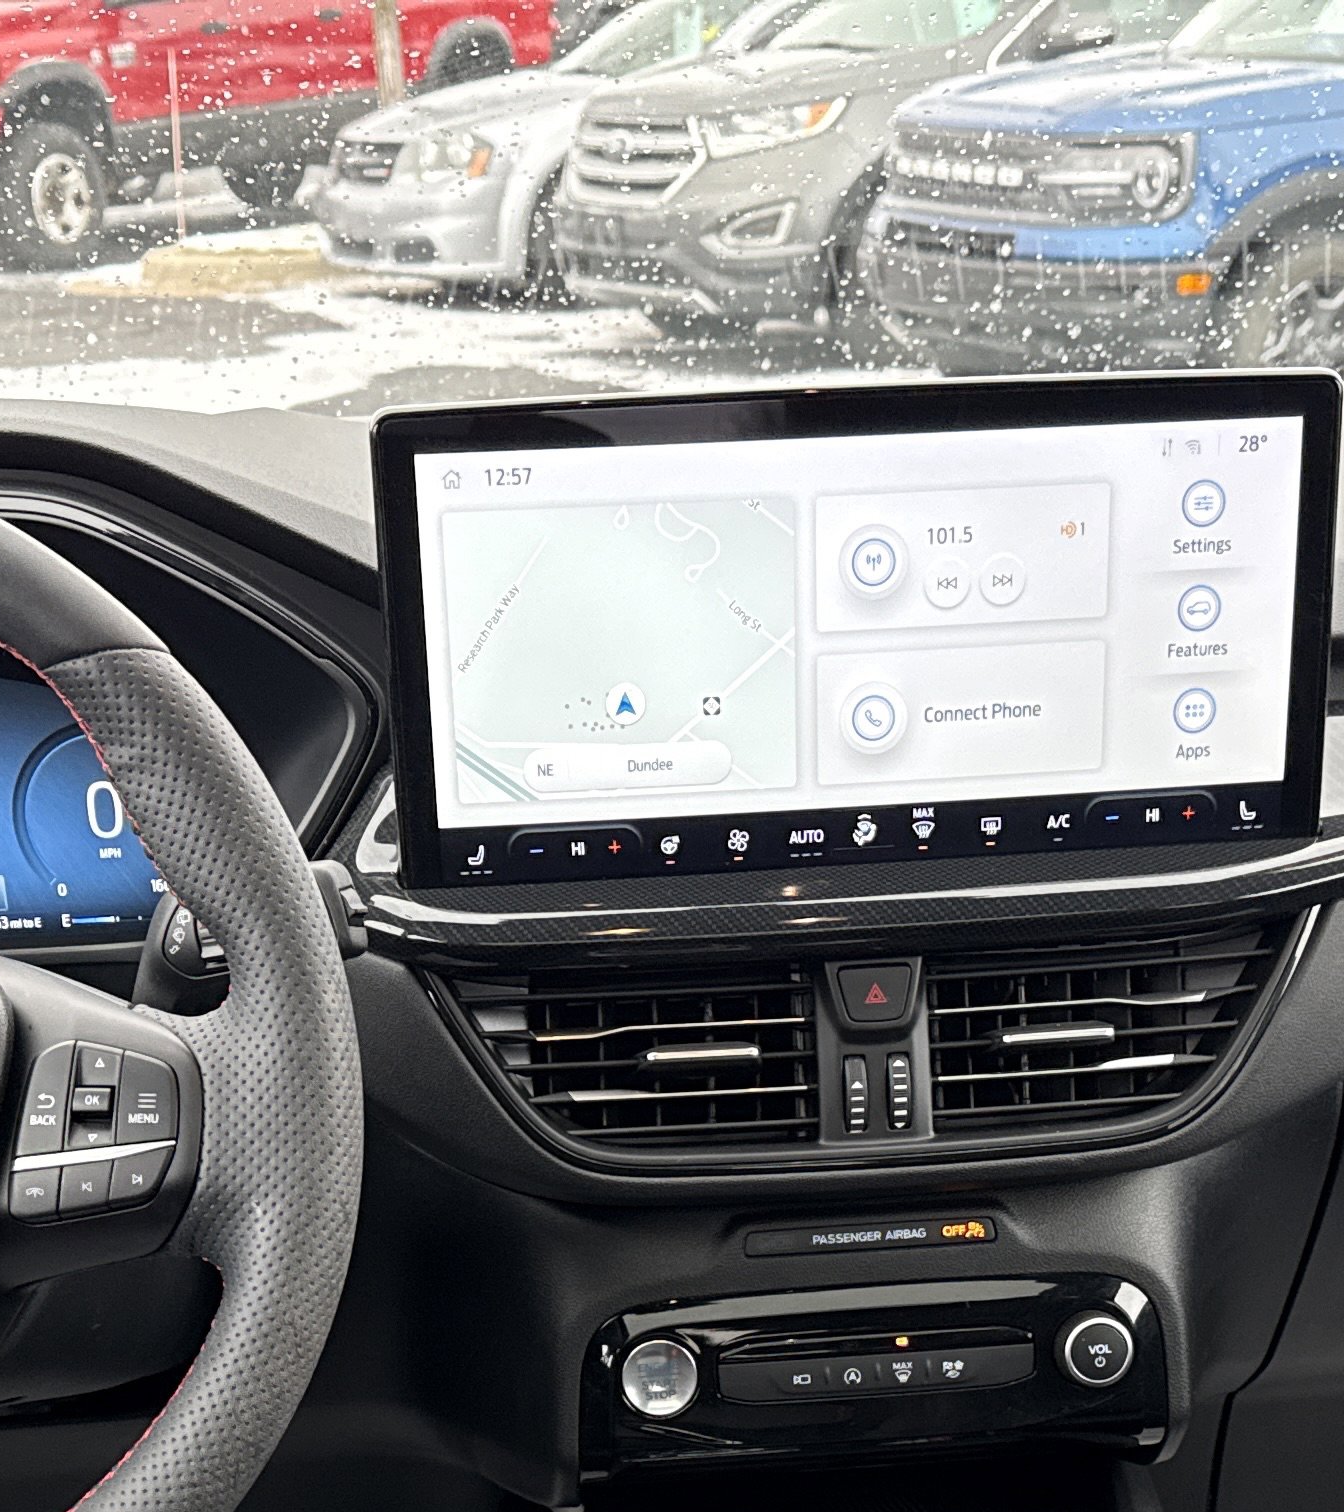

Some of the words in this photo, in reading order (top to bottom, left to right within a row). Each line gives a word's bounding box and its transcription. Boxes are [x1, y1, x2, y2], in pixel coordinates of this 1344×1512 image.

[1238, 434, 1268, 453] 28°
[484, 467, 532, 486] 12:57
[927, 526, 973, 545] 101.5
[1173, 538, 1232, 555] Settings
[728, 599, 752, 627] Long
[748, 619, 763, 634] St
[458, 626, 490, 674] Research
[485, 606, 506, 632] Park
[501, 583, 520, 608] Way
[1167, 642, 1228, 658] Features
[924, 704, 988, 724] Connect
[992, 702, 1042, 720] Phone
[1175, 744, 1211, 760] Apps
[537, 764, 554, 776] NE
[628, 758, 674, 772] Dundee
[86, 780, 124, 839] 0
[912, 807, 935, 819] MAX
[1145, 808, 1160, 823] HI
[1046, 814, 1070, 830] A/C
[790, 829, 824, 845] AUTO
[99, 847, 122, 859] MPH
[571, 841, 585, 856] HI
[57, 883, 68, 896] 0
[9, 918, 23, 929] mi
[23, 918, 34, 929] to
[61, 913, 71, 928] E
[84, 1095, 100, 1106] OK
[29, 1114, 57, 1126] BACK
[128, 1113, 160, 1124] MENU
[812, 1230, 882, 1246] PASSENGER
[885, 1228, 927, 1242] AIRBAG
[941, 1224, 966, 1238] OFF
[1087, 1343, 1113, 1355] VOL
[892, 1361, 913, 1371] MAX
